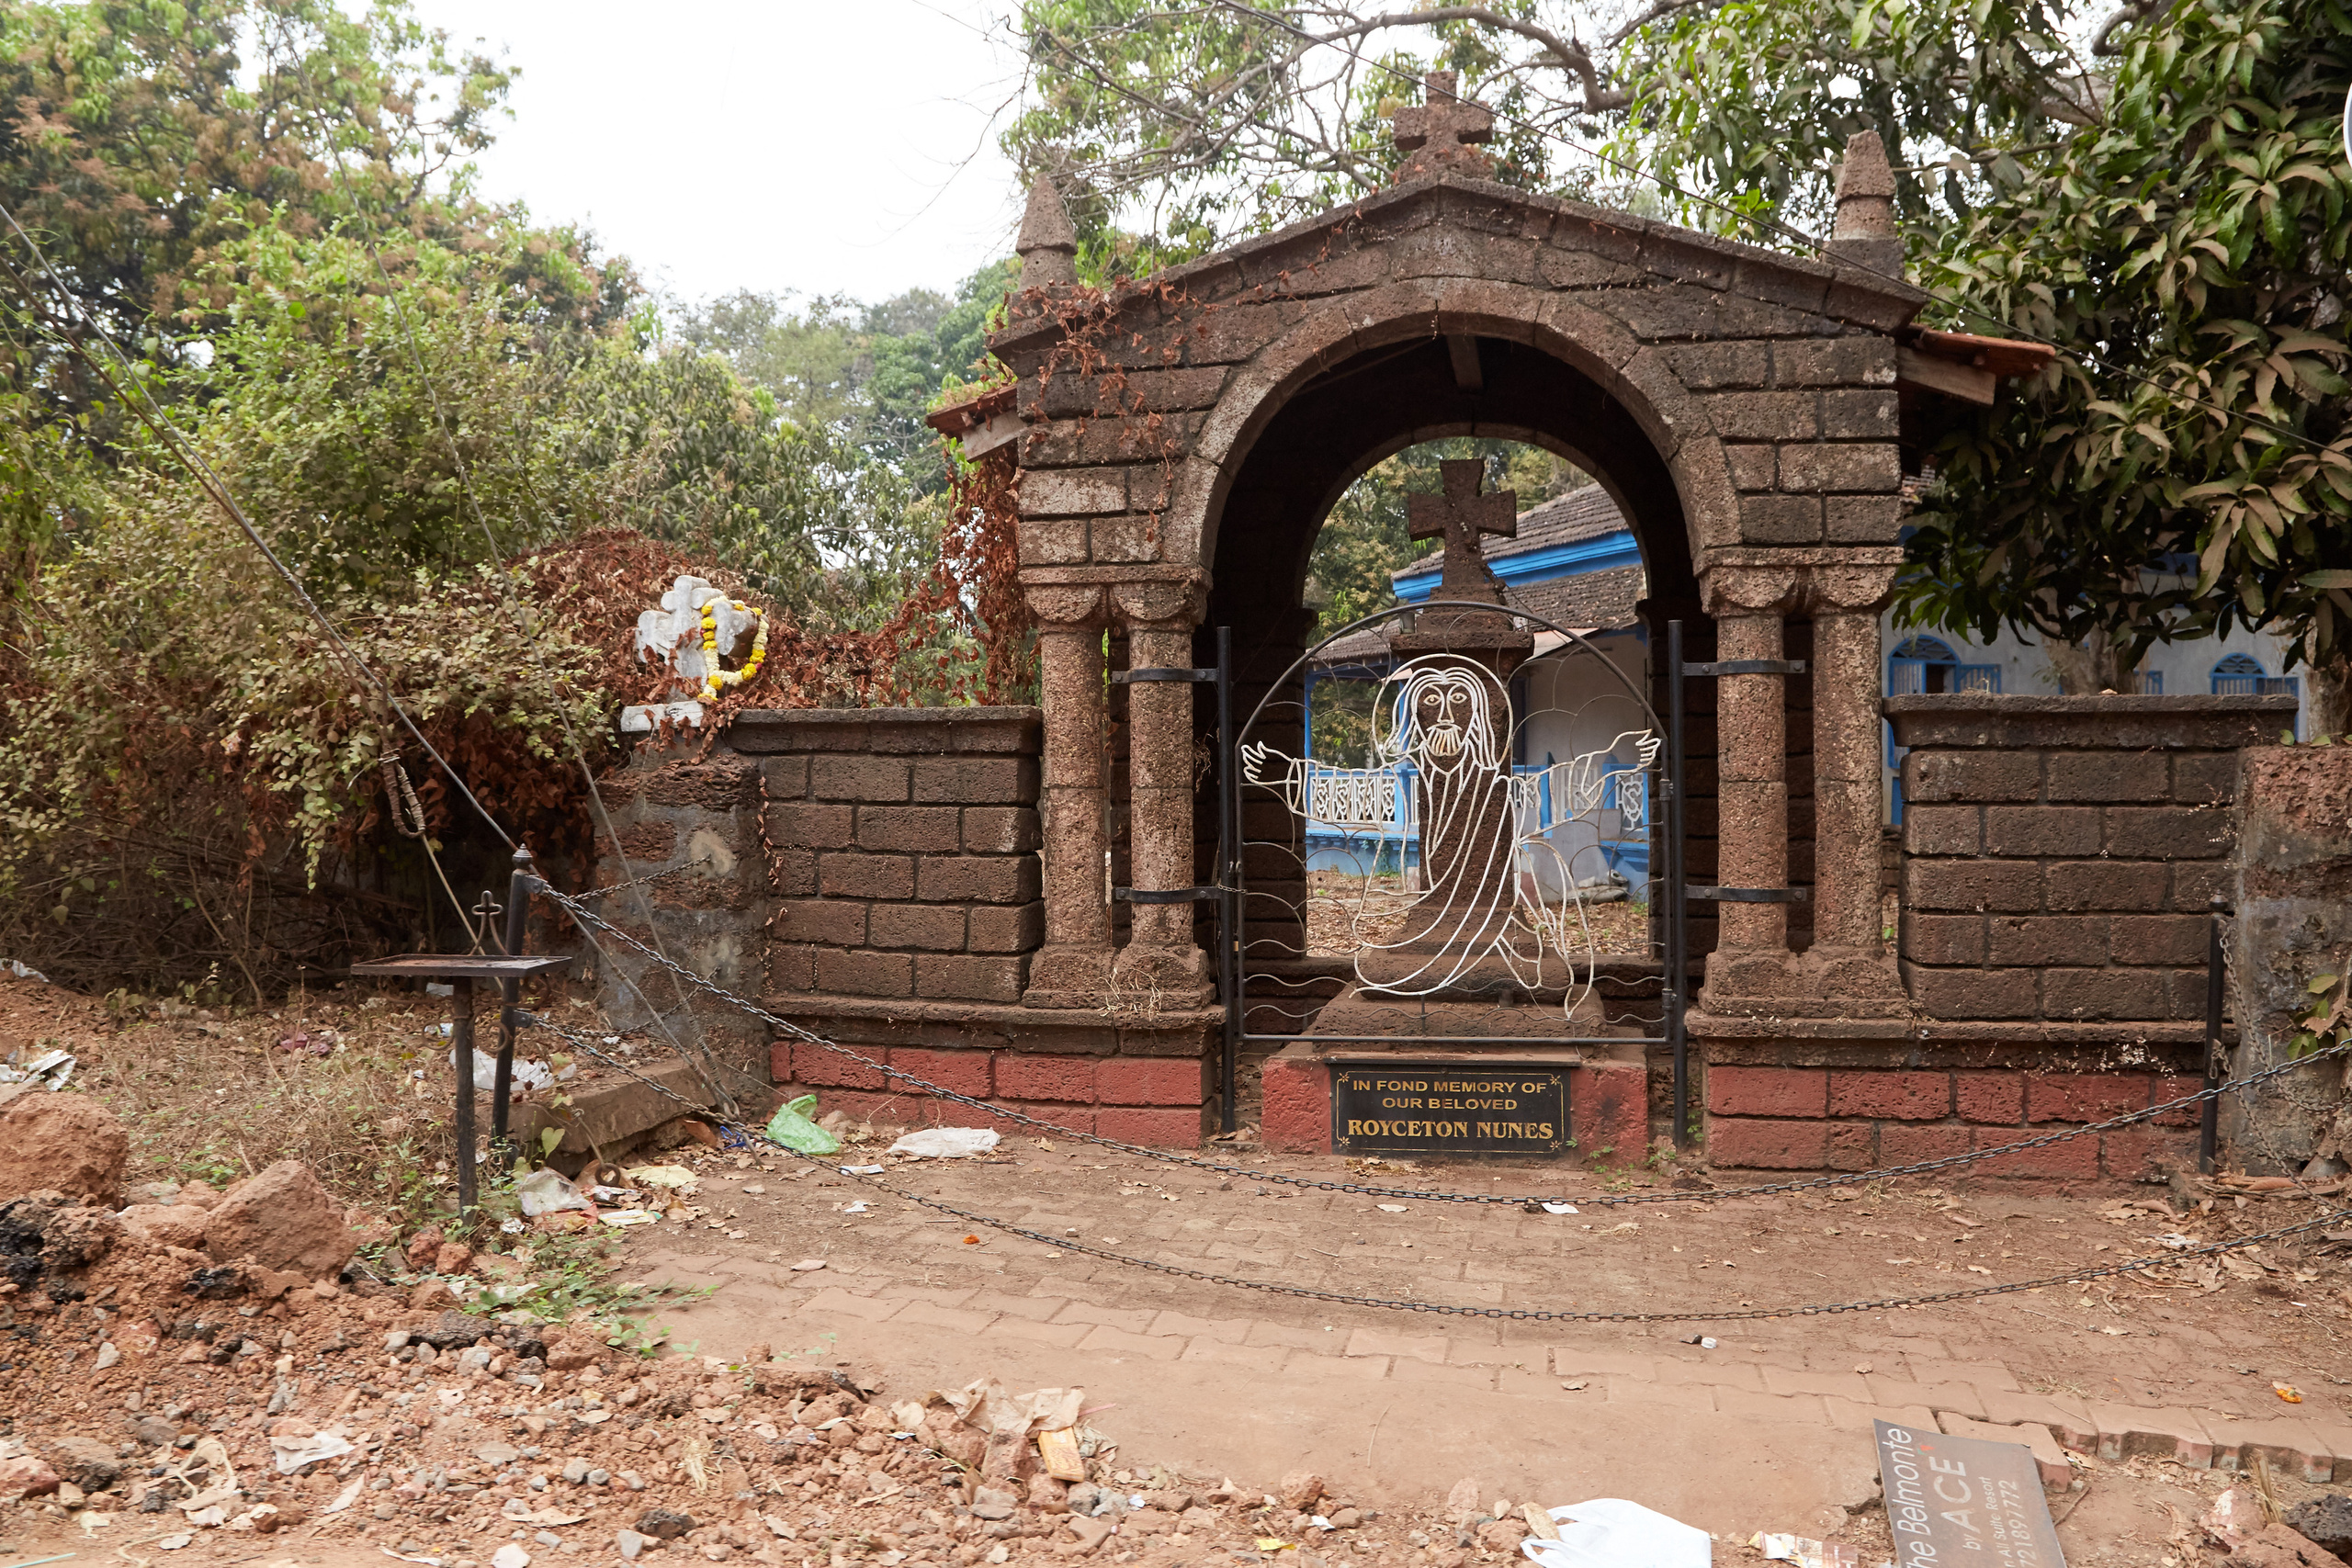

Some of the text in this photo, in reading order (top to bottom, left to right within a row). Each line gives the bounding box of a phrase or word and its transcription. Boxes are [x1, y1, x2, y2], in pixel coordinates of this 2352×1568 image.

[1352, 1079, 1547, 1094] IN FOND MEMORY OF
[1382, 1097, 1518, 1111] OUR BELOVED
[1347, 1119, 1555, 1140] ROYCETON NUNES
[1882, 1427, 1932, 1537] Belmonte
[1978, 1475, 1999, 1510] Resort
[1928, 1455, 1984, 1551] by ACE
[1989, 1512, 2007, 1540] Suite
[1996, 1541, 2013, 1558] All
